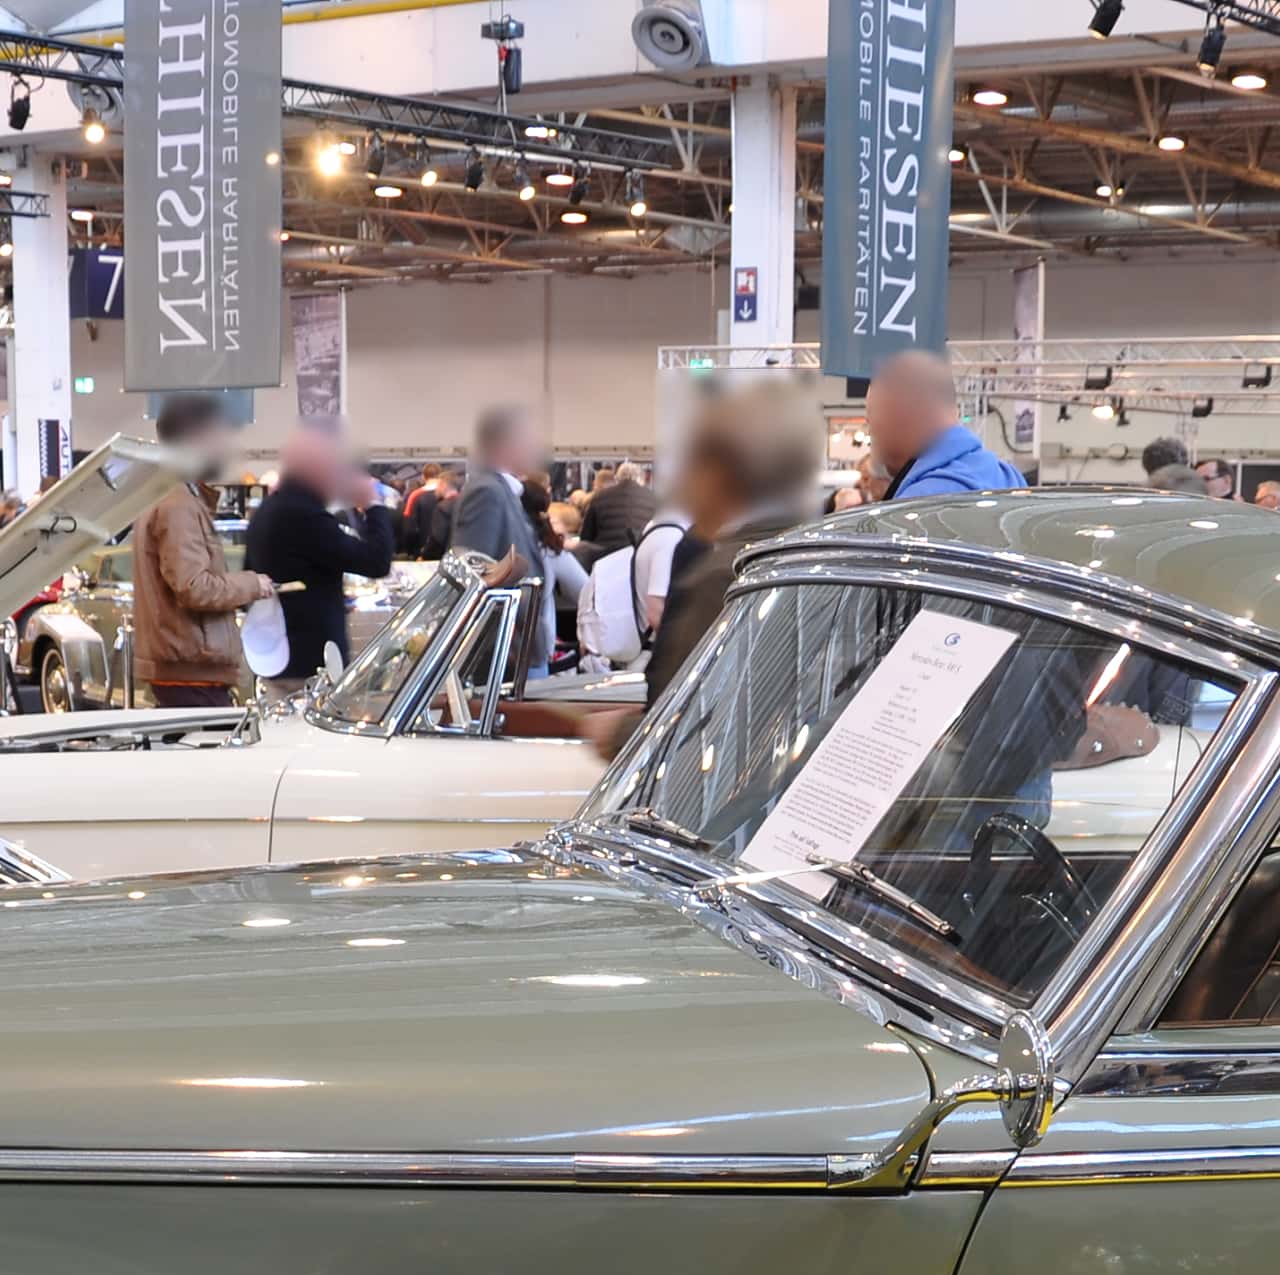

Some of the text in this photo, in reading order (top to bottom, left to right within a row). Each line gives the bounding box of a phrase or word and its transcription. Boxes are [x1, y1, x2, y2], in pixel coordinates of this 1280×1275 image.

[853, 135, 871, 335] RARITÄTEN
[98, 255, 124, 313] 7
[61, 426, 70, 478] AUT
